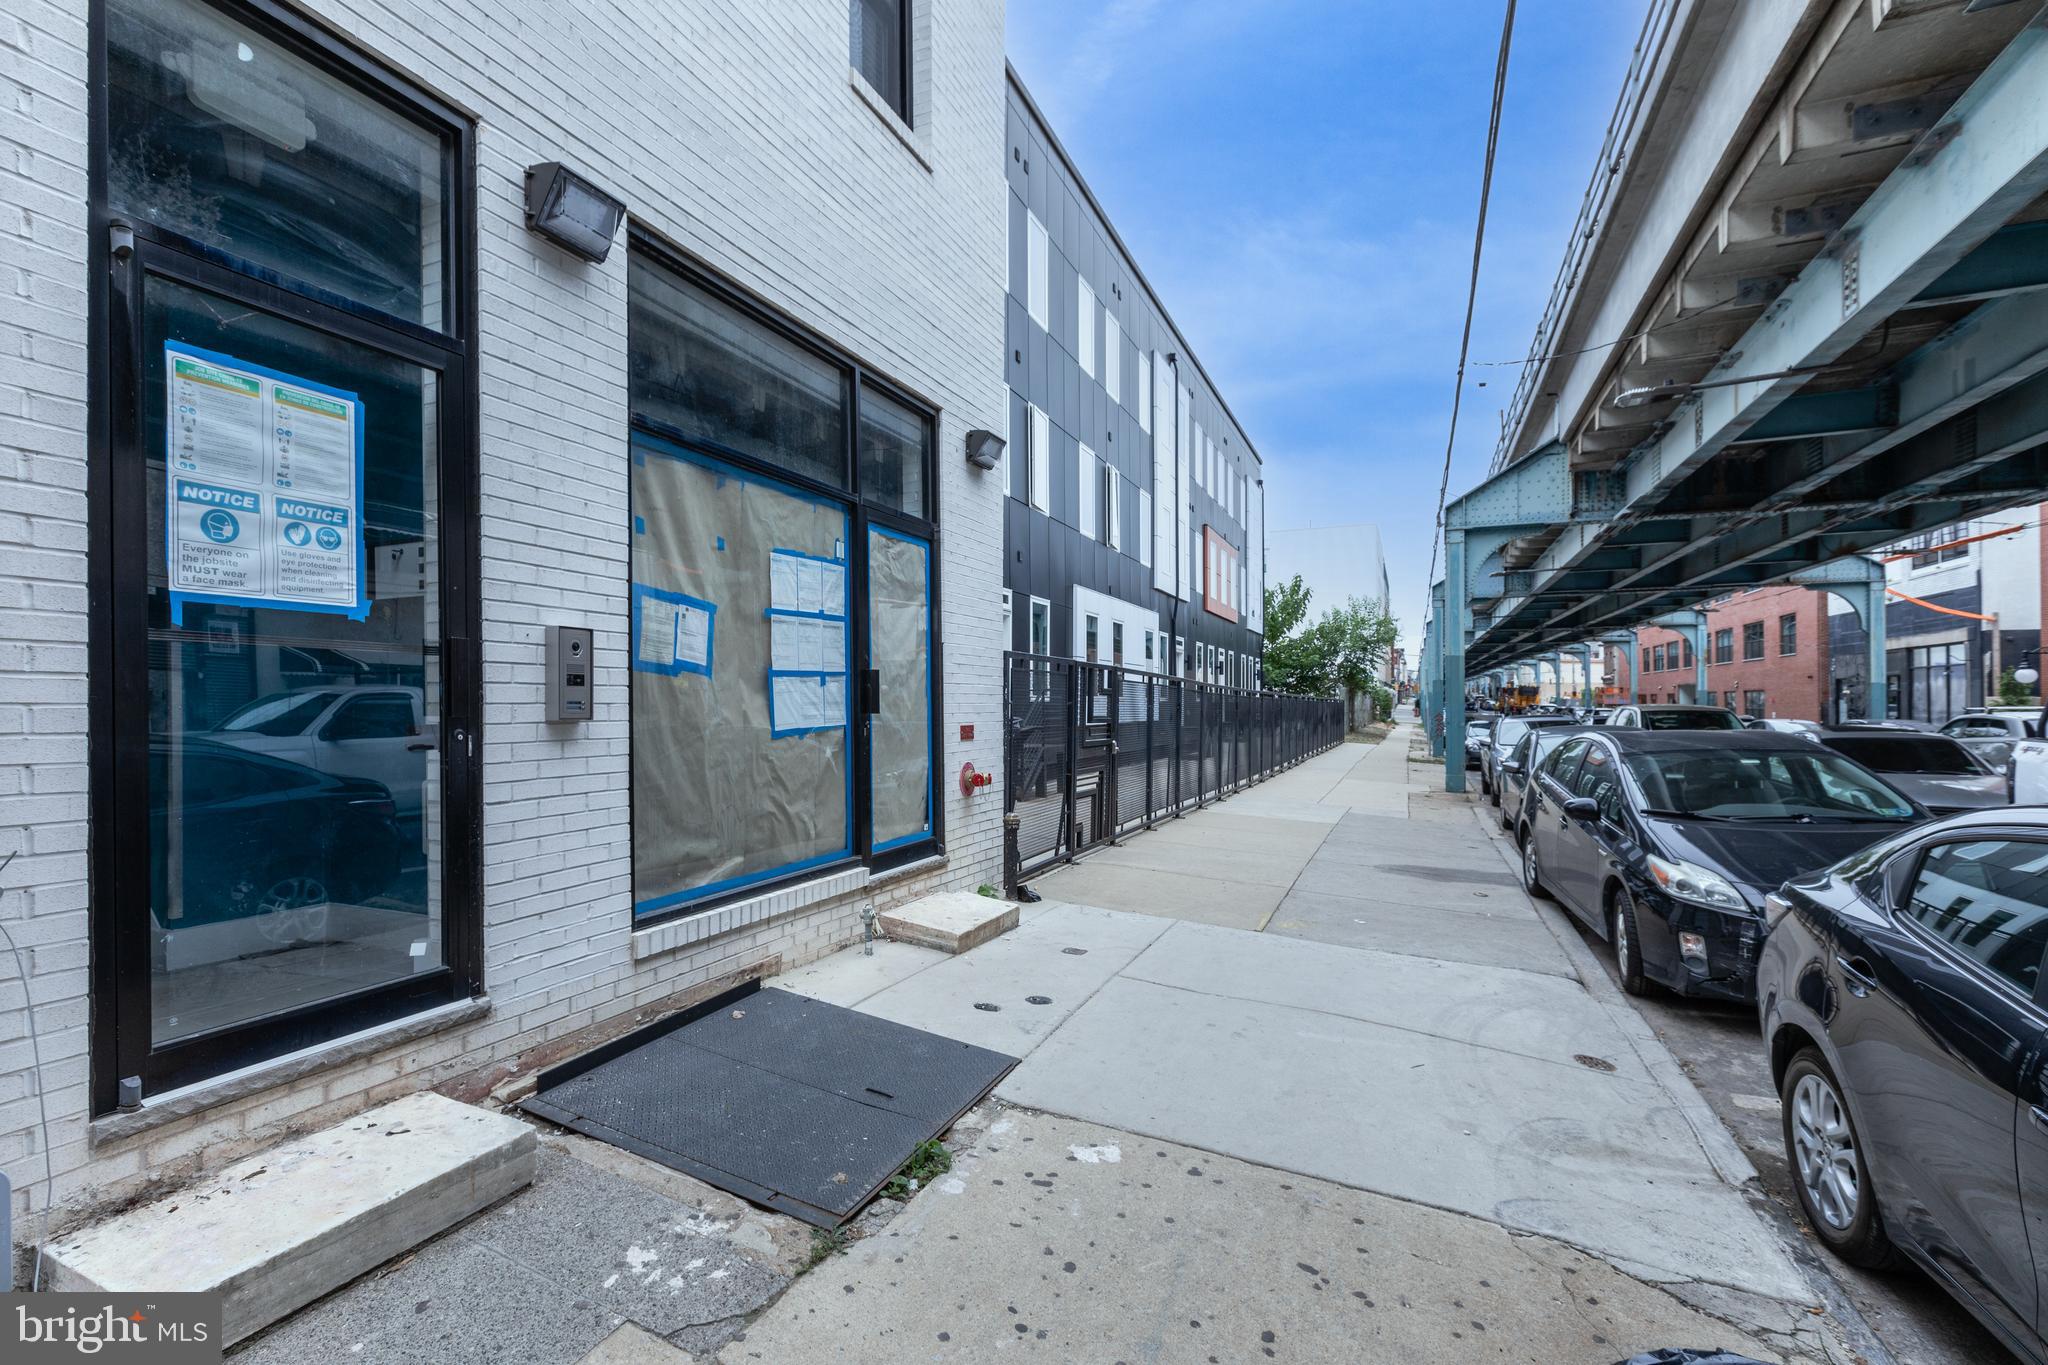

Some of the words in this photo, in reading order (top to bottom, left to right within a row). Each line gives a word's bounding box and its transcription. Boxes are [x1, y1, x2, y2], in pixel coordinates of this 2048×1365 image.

[183, 486, 255, 508] NOTICE
[281, 503, 344, 523] NOTICE
[183, 543, 233, 557] Everyone
[235, 551, 249, 559] on
[281, 549, 297, 557] Use
[299, 551, 325, 561] gloves
[327, 555, 341, 563] and
[182, 554, 199, 563] the
[201, 555, 239, 567] jobsite
[297, 560, 337, 571] protection
[182, 564, 219, 576] MUST
[222, 571, 248, 579] wear
[281, 567, 303, 575] when
[304, 569, 338, 580] cleaning
[192, 575, 215, 585] face
[298, 576, 344, 588] disinfecting
